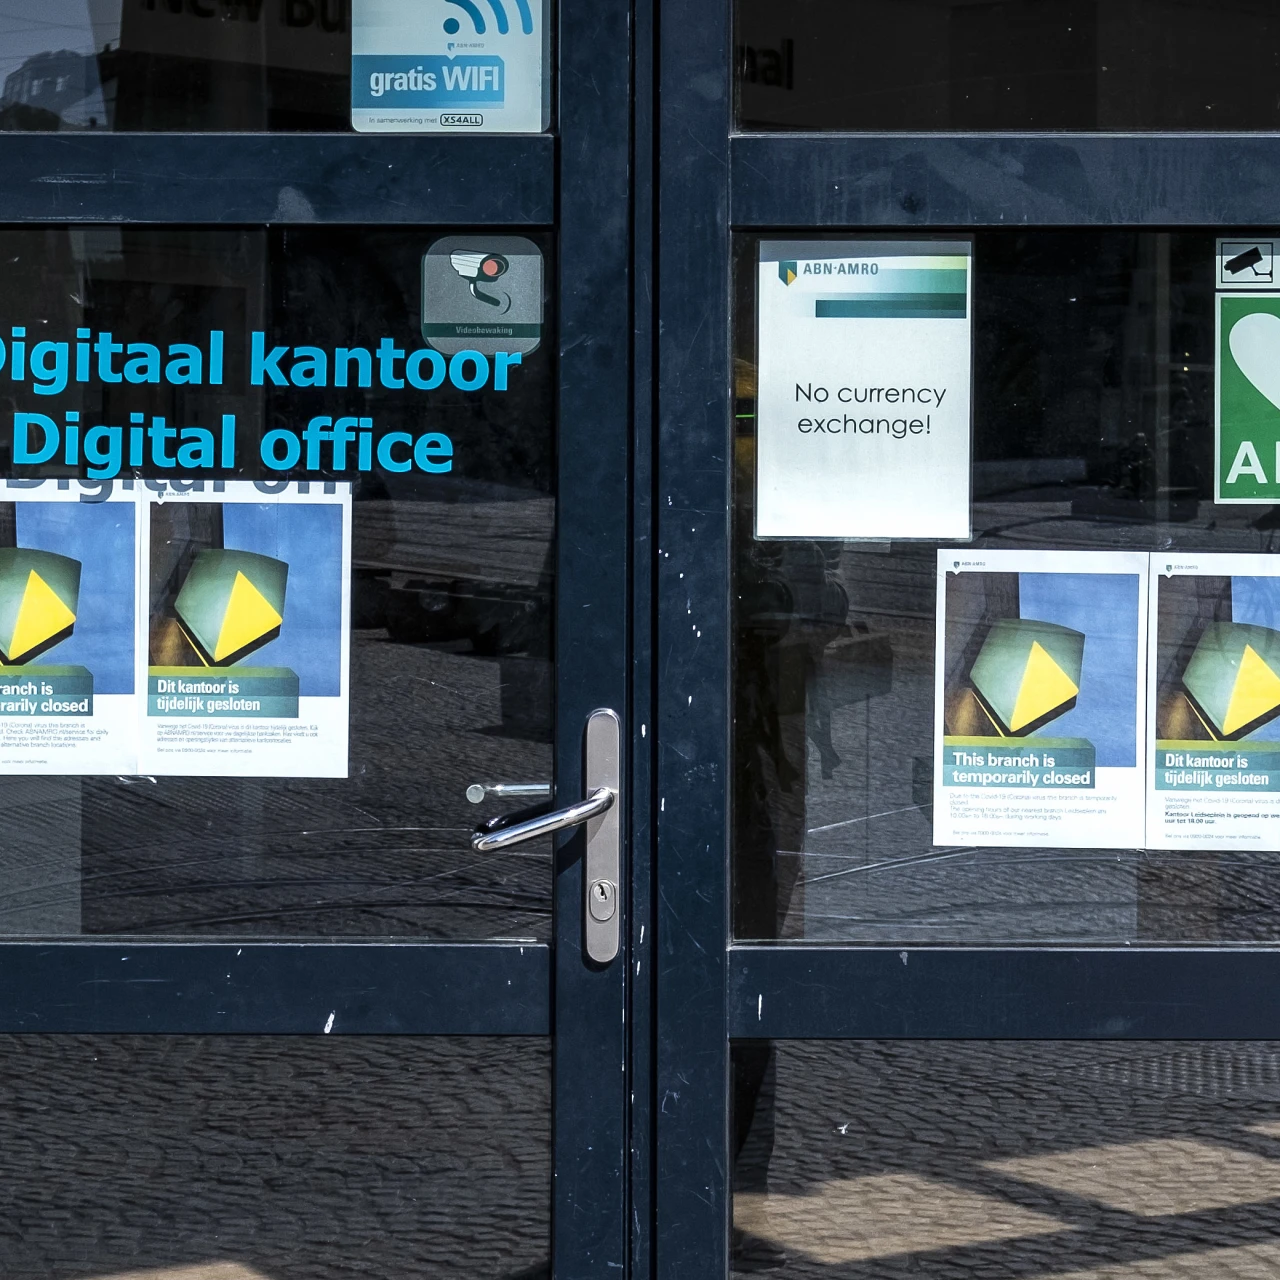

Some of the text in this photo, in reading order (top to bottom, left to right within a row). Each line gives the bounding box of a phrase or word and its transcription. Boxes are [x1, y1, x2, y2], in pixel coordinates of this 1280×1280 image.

[370, 66, 499, 97] gratis WIFI
[443, 116, 480, 124] XS4ALL
[456, 326, 513, 335] Videobewaking
[250, 332, 523, 392] kantoor
[795, 383, 947, 409] No currency
[797, 414, 932, 440] exchange!
[12, 411, 454, 480] Digital office
[41, 682, 54, 696] is
[158, 680, 240, 694] Dit kantoor is
[40, 698, 88, 712] closed
[156, 697, 260, 713] tijdelijk gesloten
[952, 752, 1056, 767] This branch is
[1165, 754, 1248, 769] Dit kantoor is
[952, 770, 1091, 786] temporarily closed
[1164, 771, 1269, 788] tijdelijk gesloten
